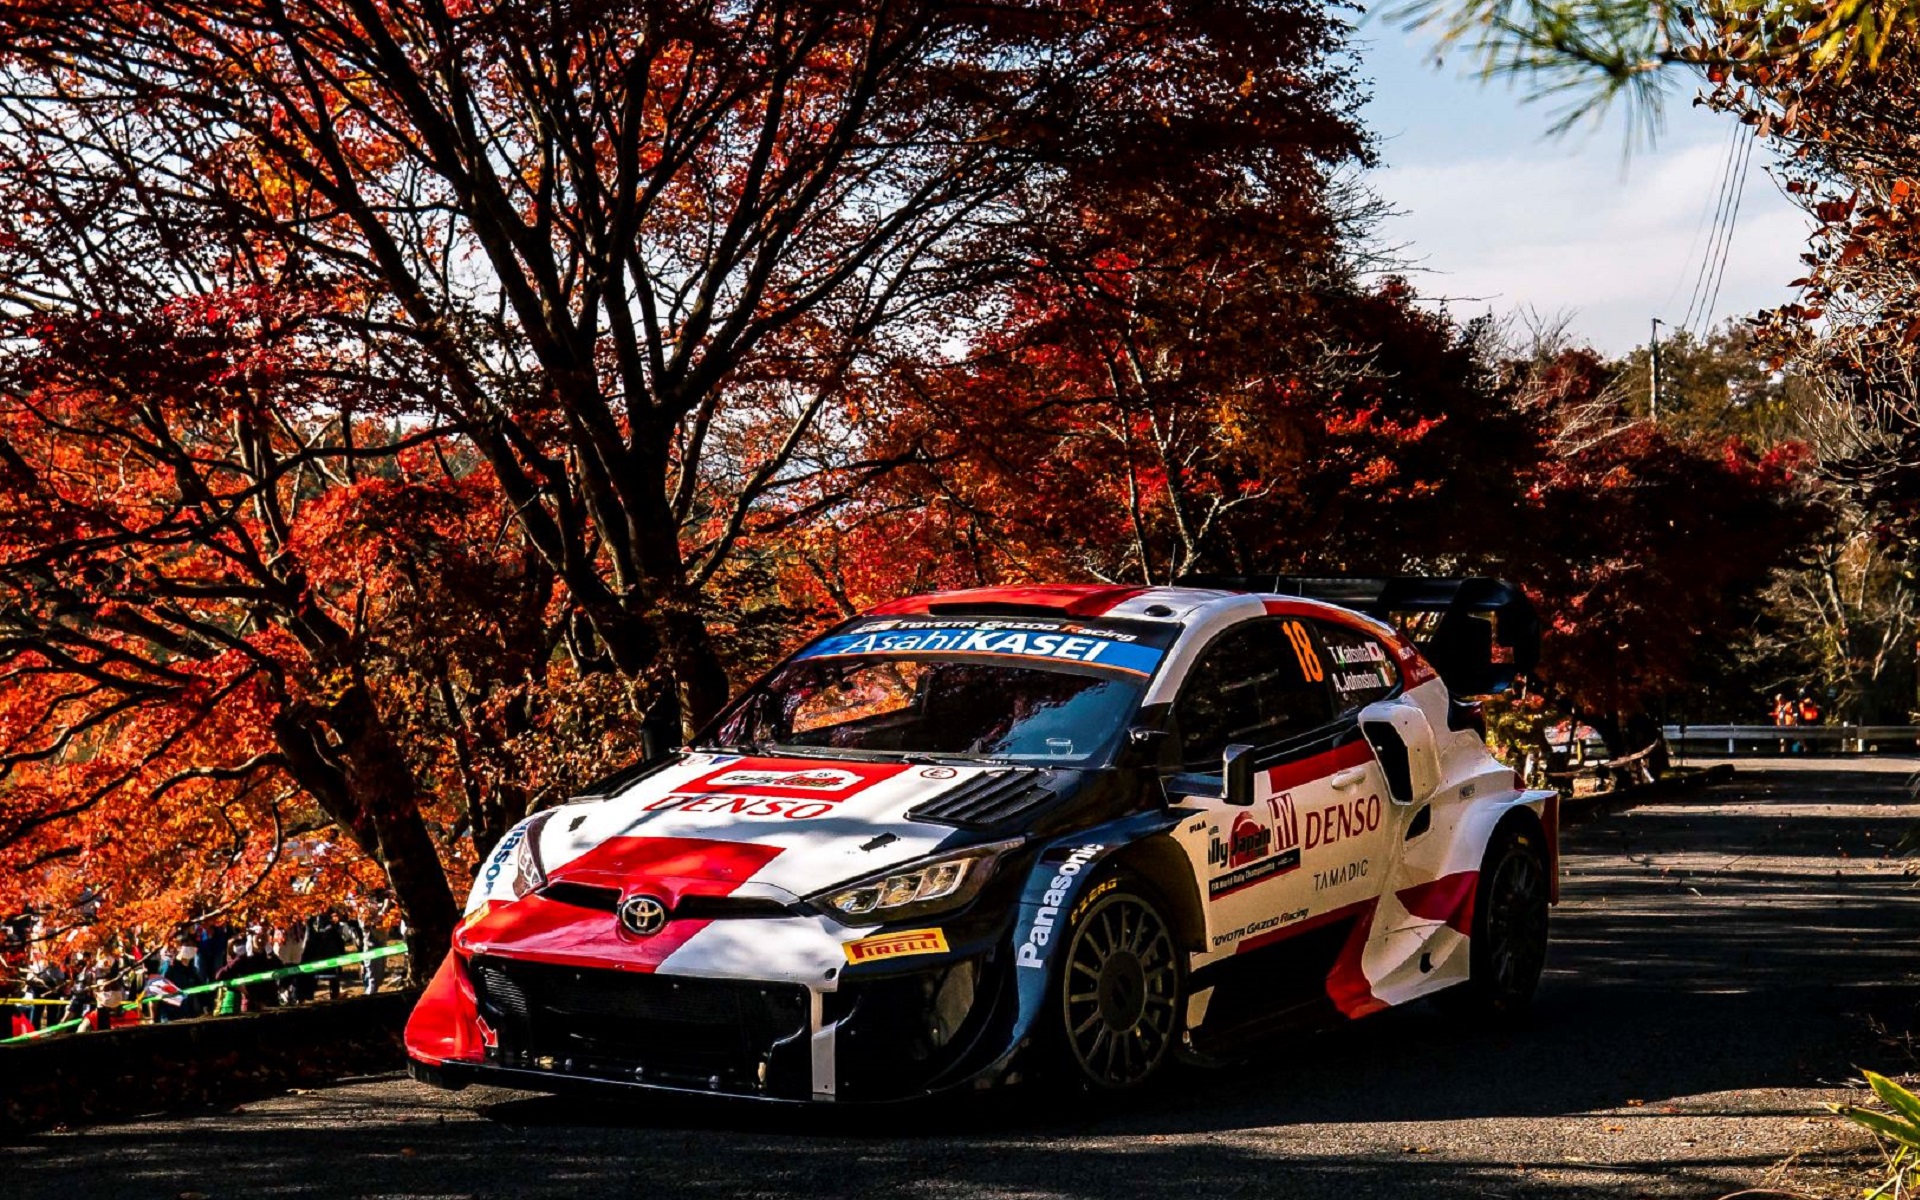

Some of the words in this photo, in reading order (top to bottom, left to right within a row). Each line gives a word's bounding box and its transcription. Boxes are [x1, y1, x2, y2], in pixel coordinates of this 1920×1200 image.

[843, 629, 1110, 661] AsahiKASEI
[976, 620, 1059, 631] GAZOO
[1059, 623, 1138, 642] Racing
[1281, 620, 1324, 683] 18
[642, 795, 833, 820] DENSO
[1304, 794, 1382, 850] DENSO
[1313, 860, 1369, 892] TAMADIC
[1016, 842, 1105, 969] Panasonic
[1247, 916, 1280, 935] GAZOO
[1280, 908, 1309, 924] Racing
[851, 933, 940, 959] PIRELLI
